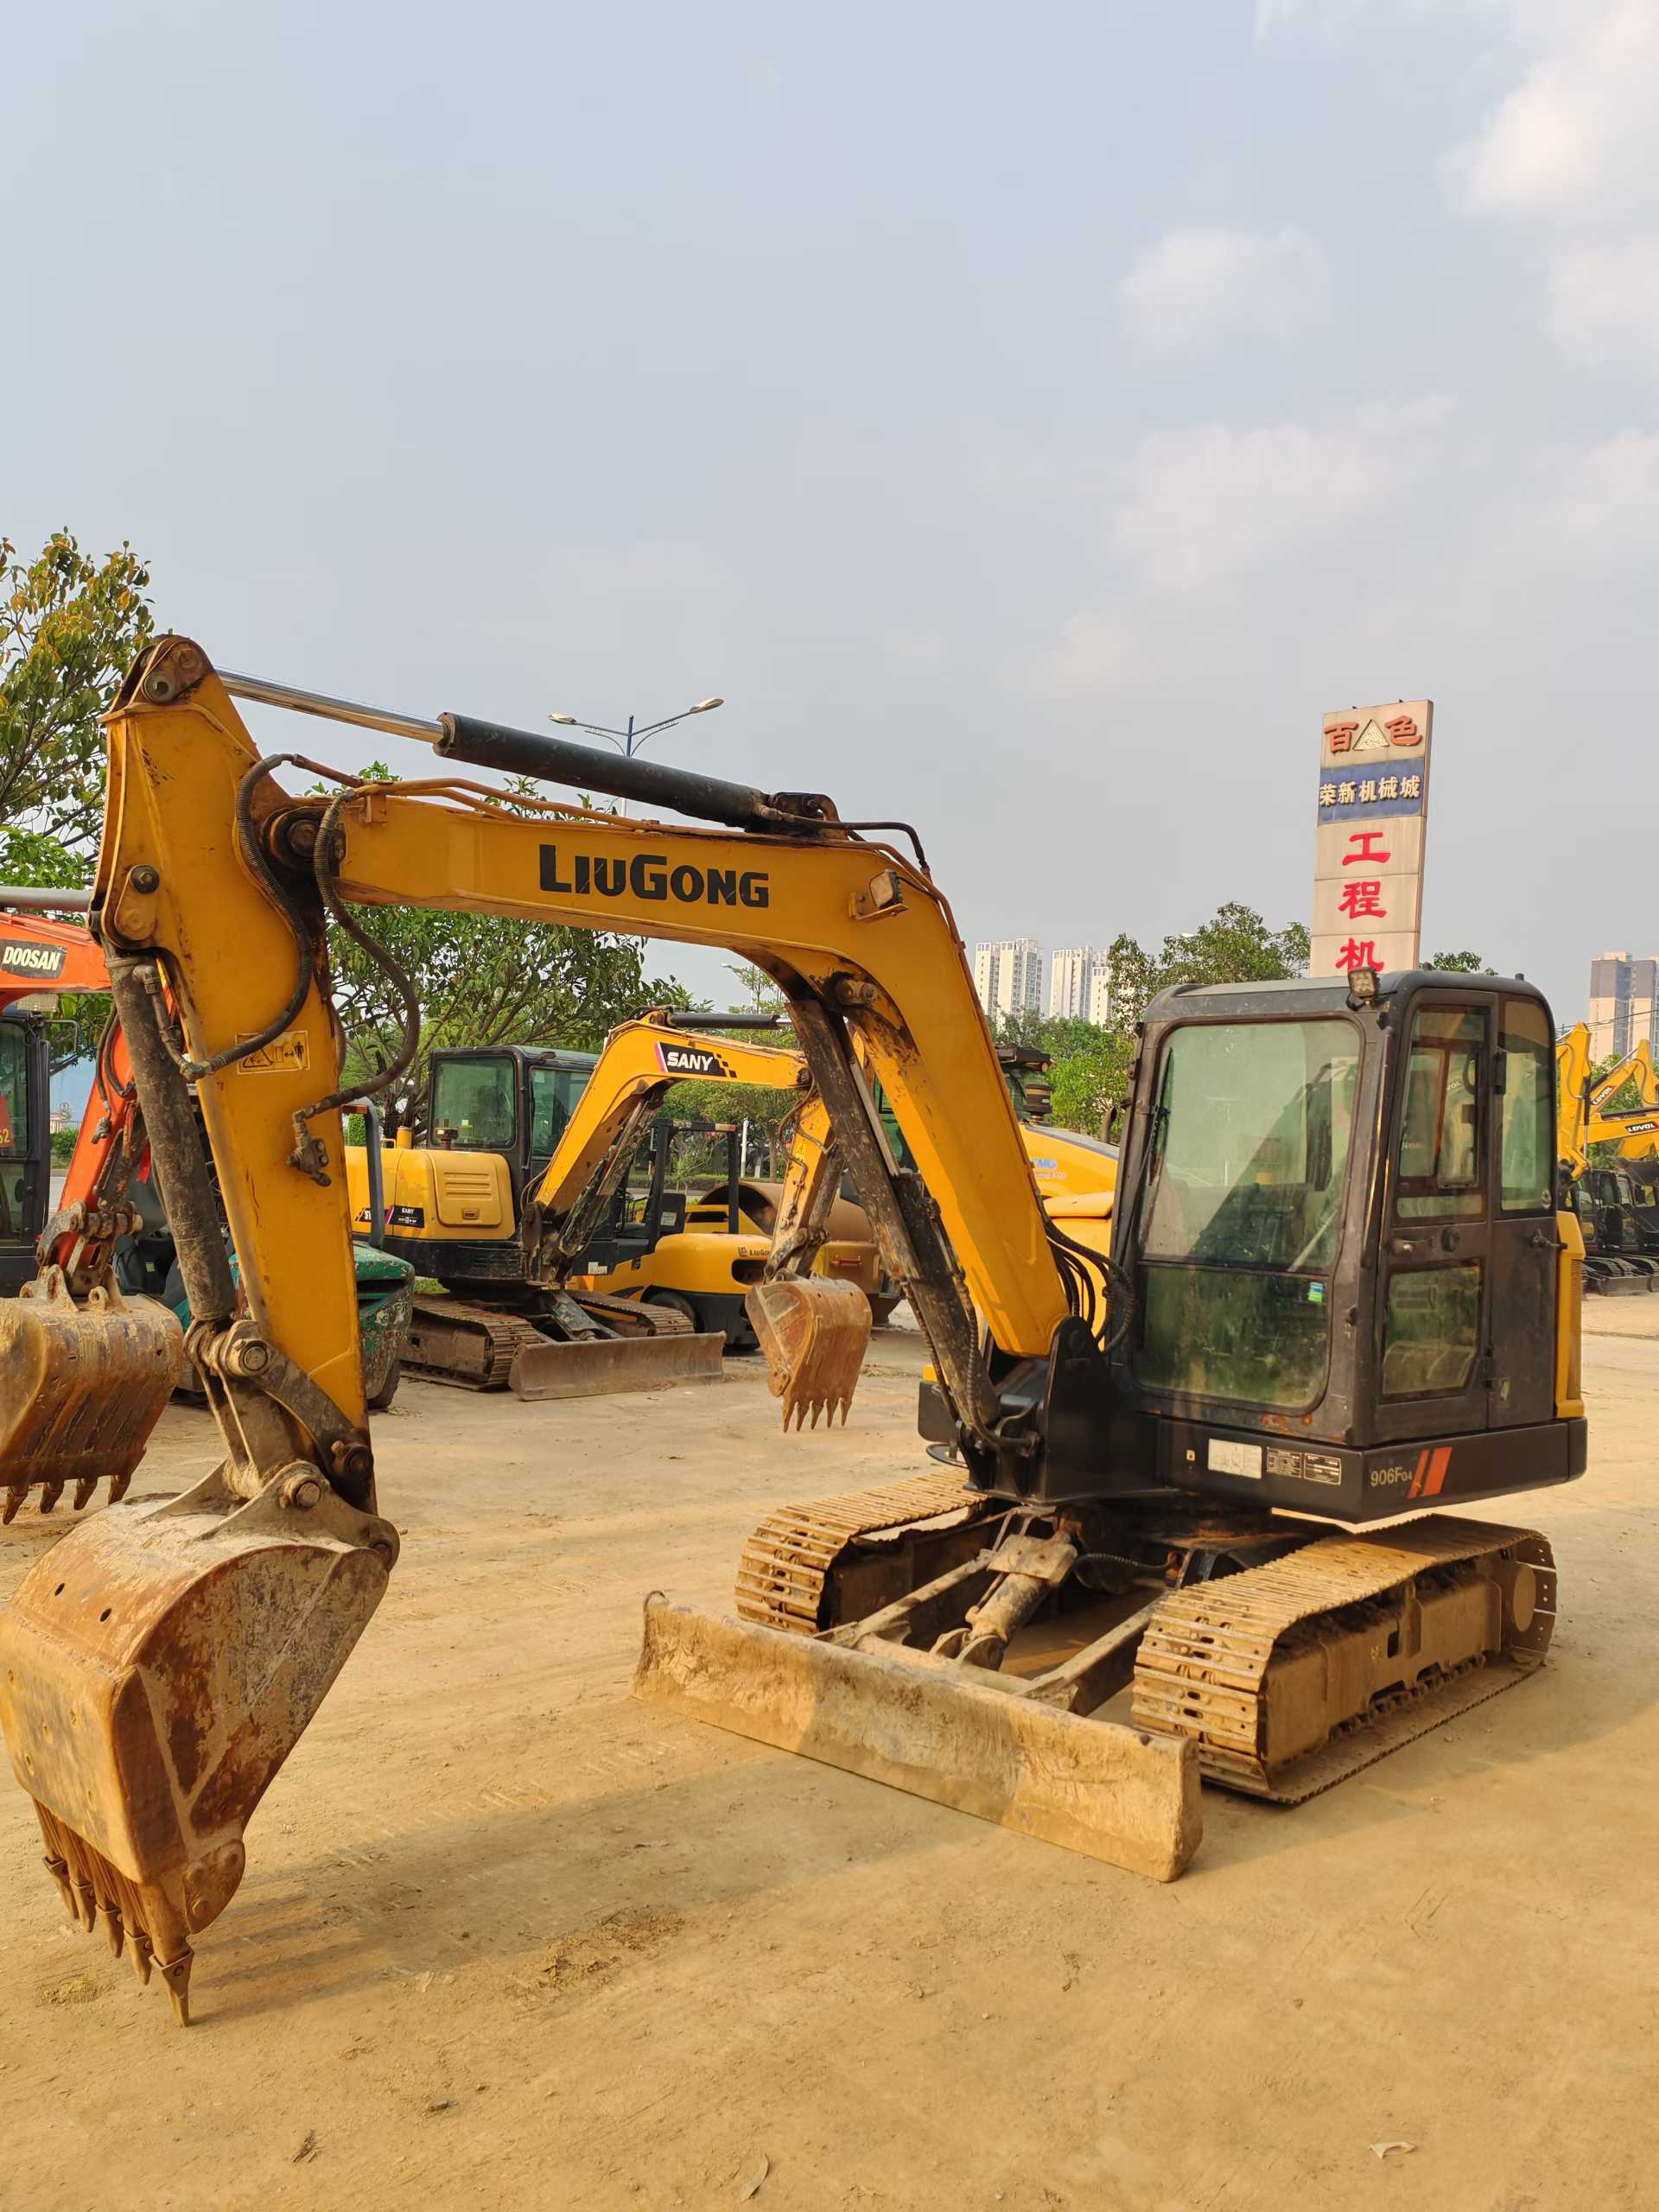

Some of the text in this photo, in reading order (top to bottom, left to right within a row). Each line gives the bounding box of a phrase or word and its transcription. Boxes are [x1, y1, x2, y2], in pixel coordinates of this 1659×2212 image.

[1319, 776, 1421, 807] 荣新机械城
[2, 946, 61, 971] DOOSAN
[667, 1052, 714, 1071] SANY
[1592, 1086, 1612, 1105] LOVOL
[1627, 1122, 1656, 1133] LOVOL
